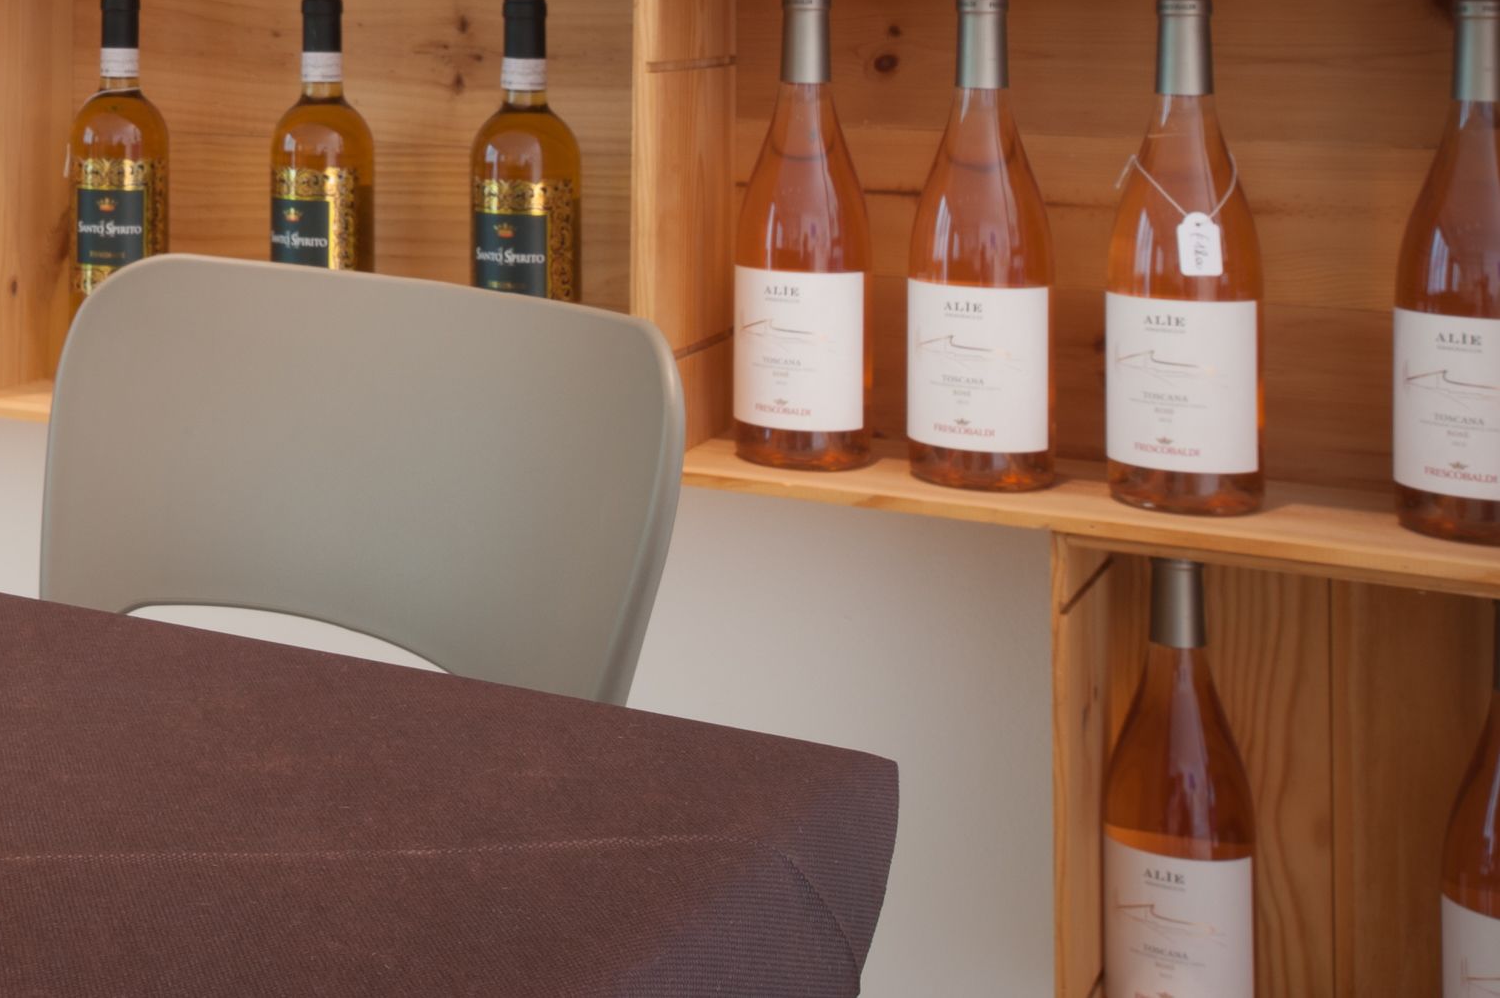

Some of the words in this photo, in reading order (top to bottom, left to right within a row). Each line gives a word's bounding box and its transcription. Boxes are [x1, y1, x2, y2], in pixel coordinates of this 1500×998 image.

[78, 219, 105, 238] SANTO
[106, 219, 142, 238] SPIRITO
[291, 231, 328, 249] SPIRITO
[476, 245, 503, 265] SANTO
[504, 246, 546, 266] SPIRITO
